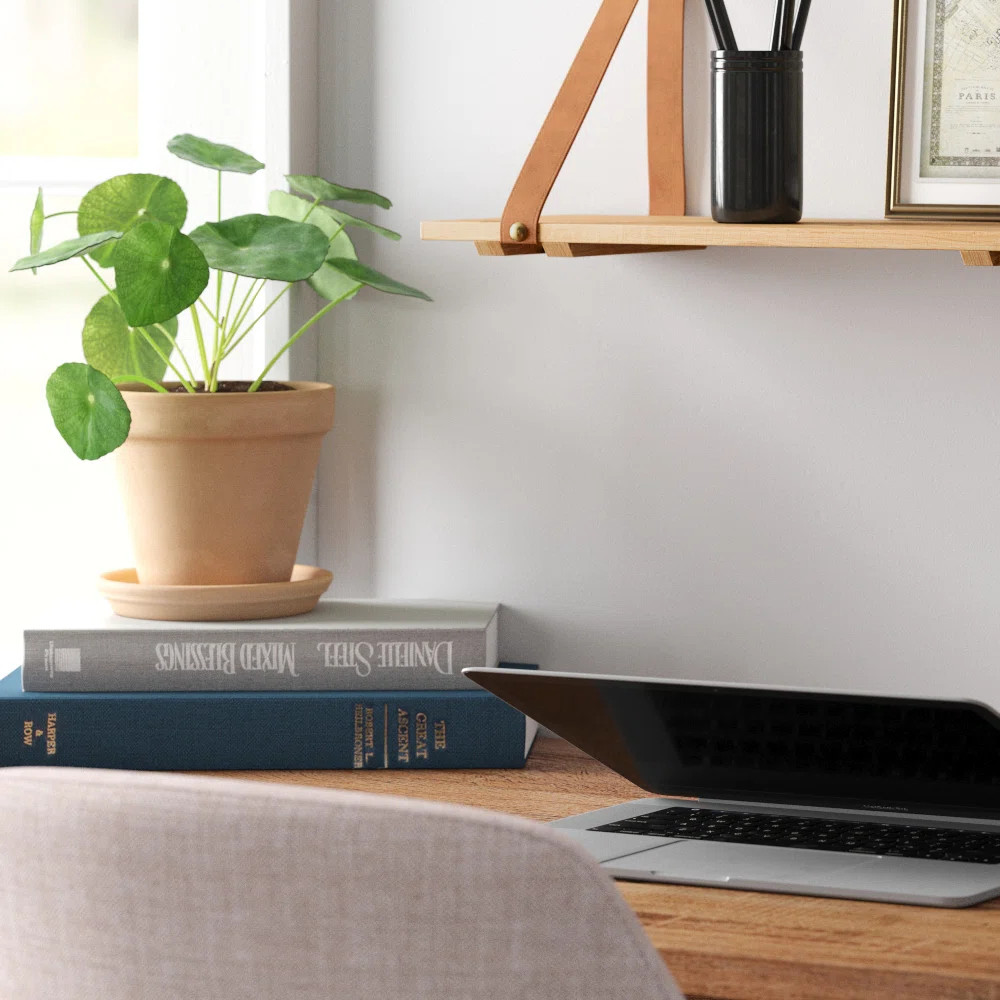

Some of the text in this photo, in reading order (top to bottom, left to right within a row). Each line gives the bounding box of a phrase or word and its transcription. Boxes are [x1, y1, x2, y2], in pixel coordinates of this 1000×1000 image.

[153, 639, 454, 678] DANIELLE STEEL MIXED BLESSINGS
[23, 721, 33, 746] ROW
[46, 712, 57, 755] HARPER
[365, 707, 375, 748] ROBERT
[397, 708, 410, 763] ASCENT
[415, 712, 428, 759] GREAT
[433, 719, 447, 750] THE
